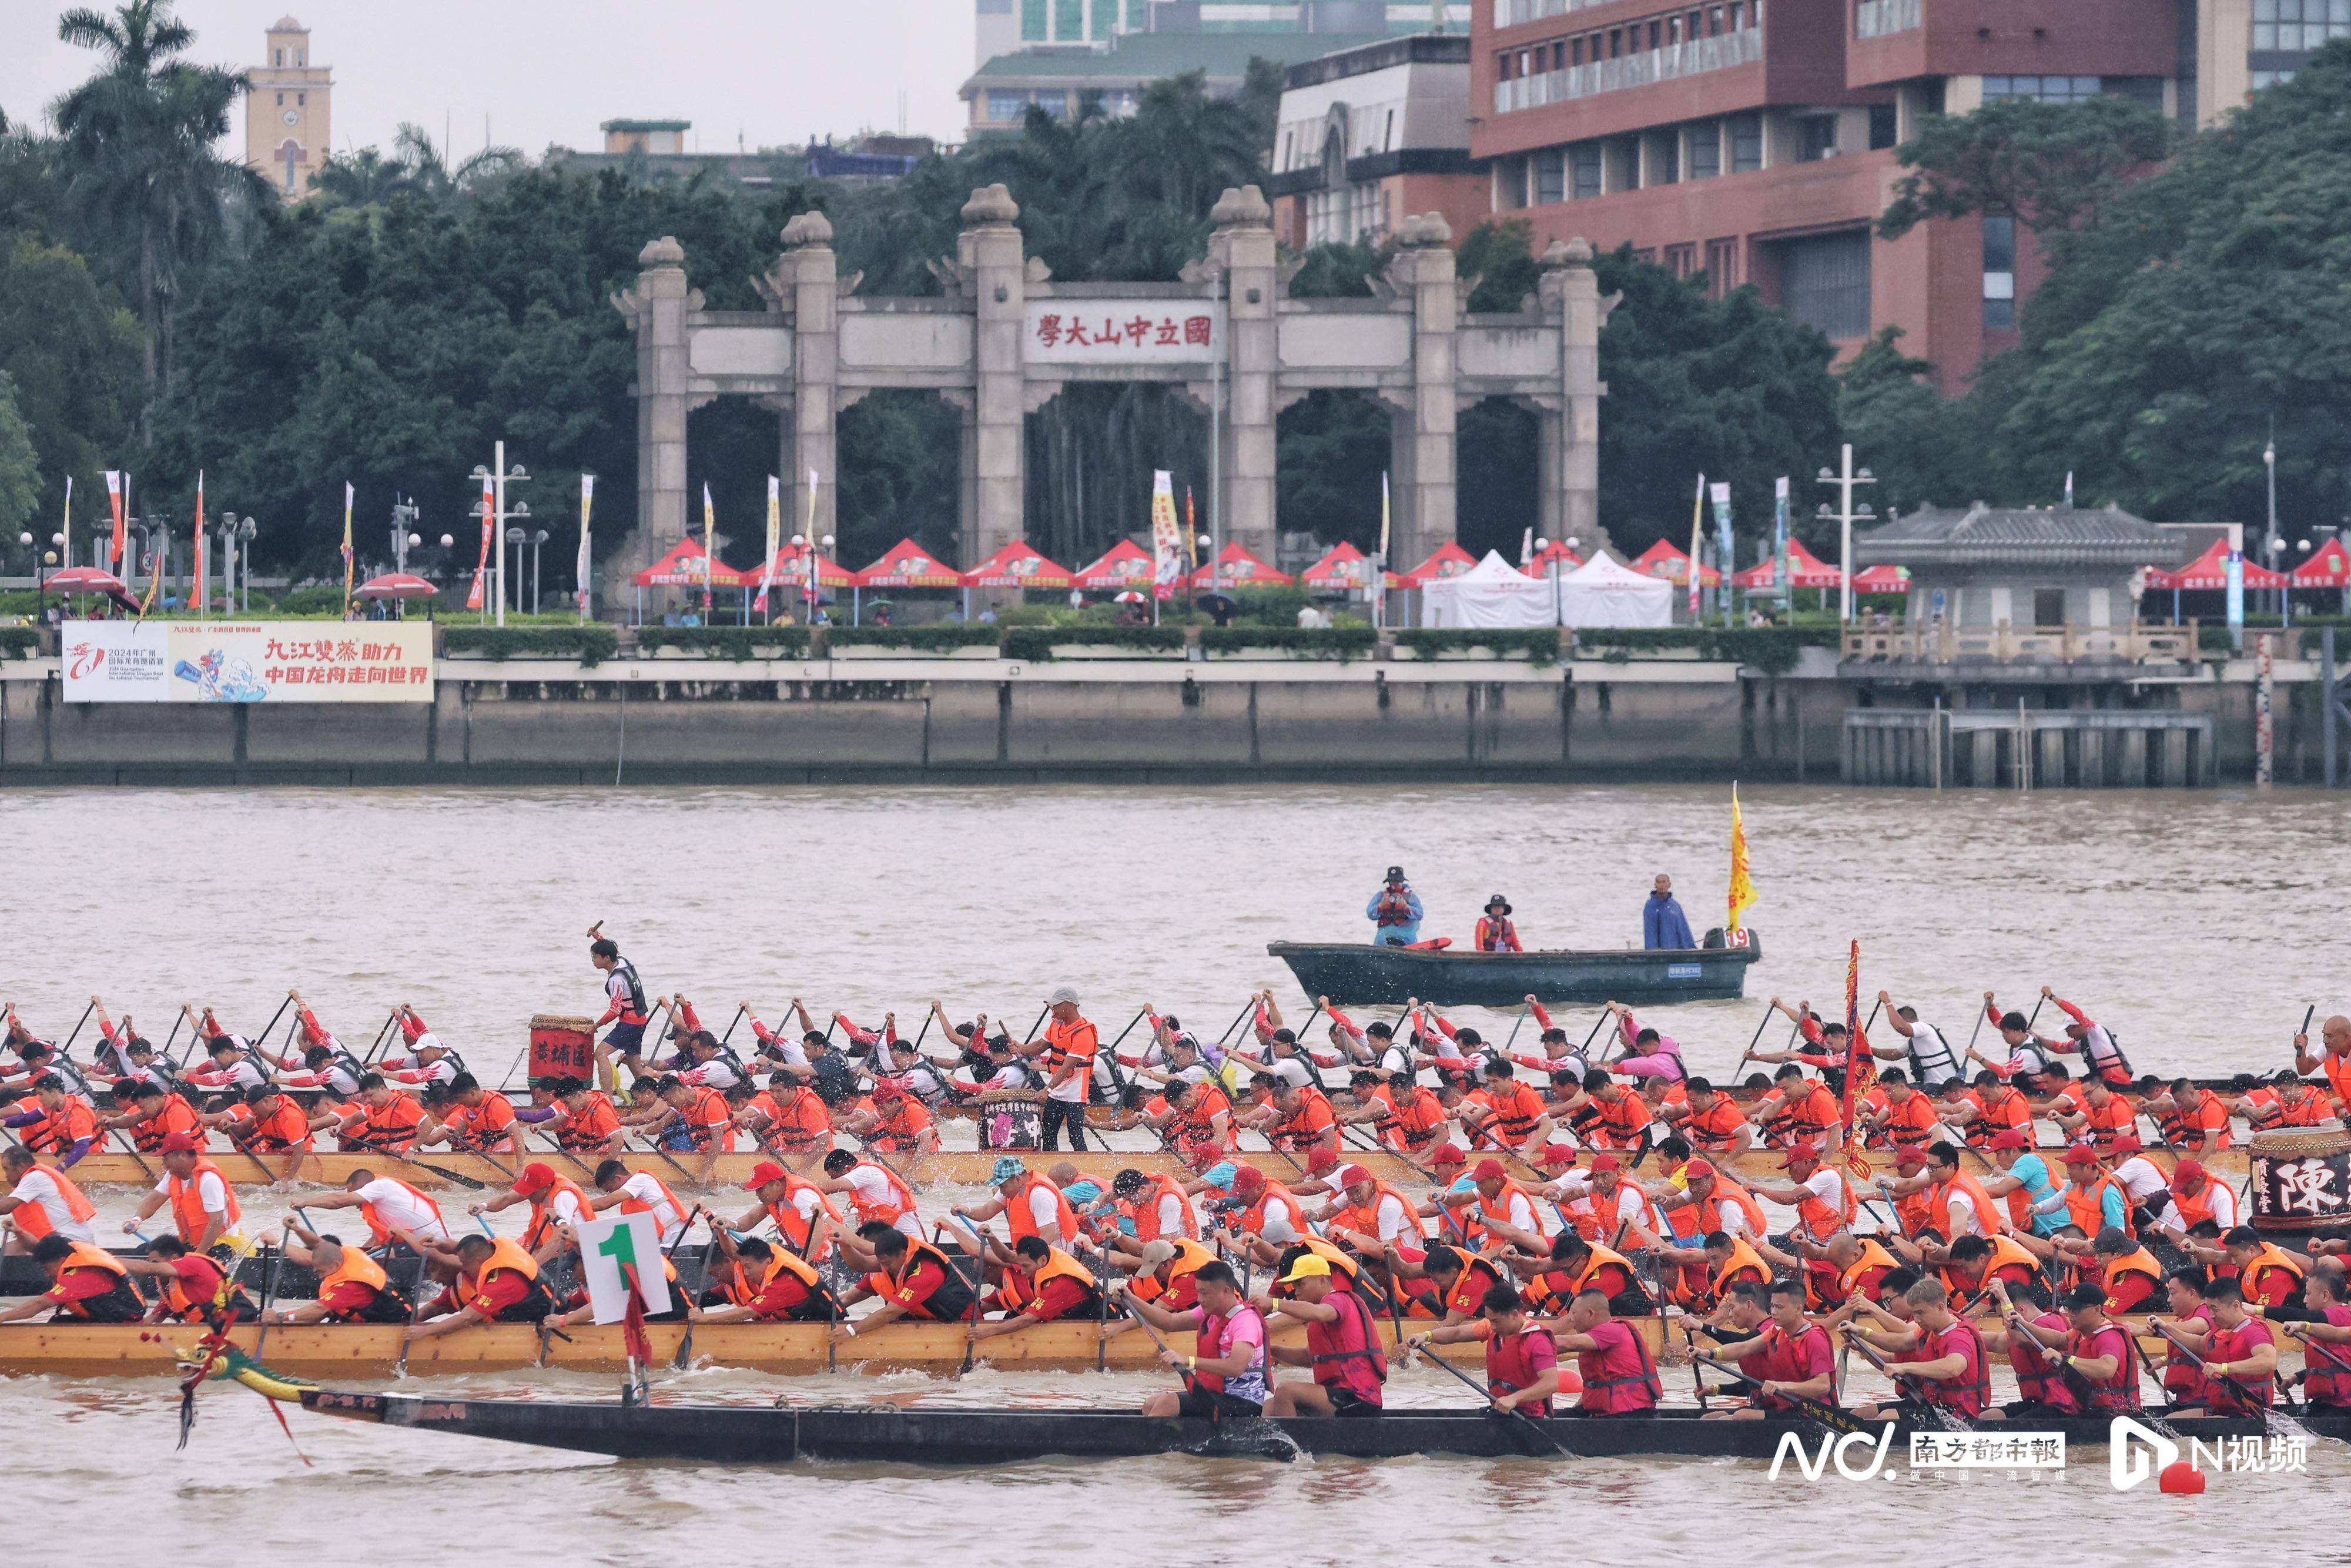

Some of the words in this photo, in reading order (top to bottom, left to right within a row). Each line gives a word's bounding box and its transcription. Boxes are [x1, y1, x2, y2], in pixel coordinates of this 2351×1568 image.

[108, 648, 156, 657] 2024年广州
[108, 657, 164, 665] 国际龙舟邀请赛
[264, 666, 428, 684] 中国龙舟走向世界
[1726, 928, 1748, 949] 19
[598, 1222, 639, 1291] 1
